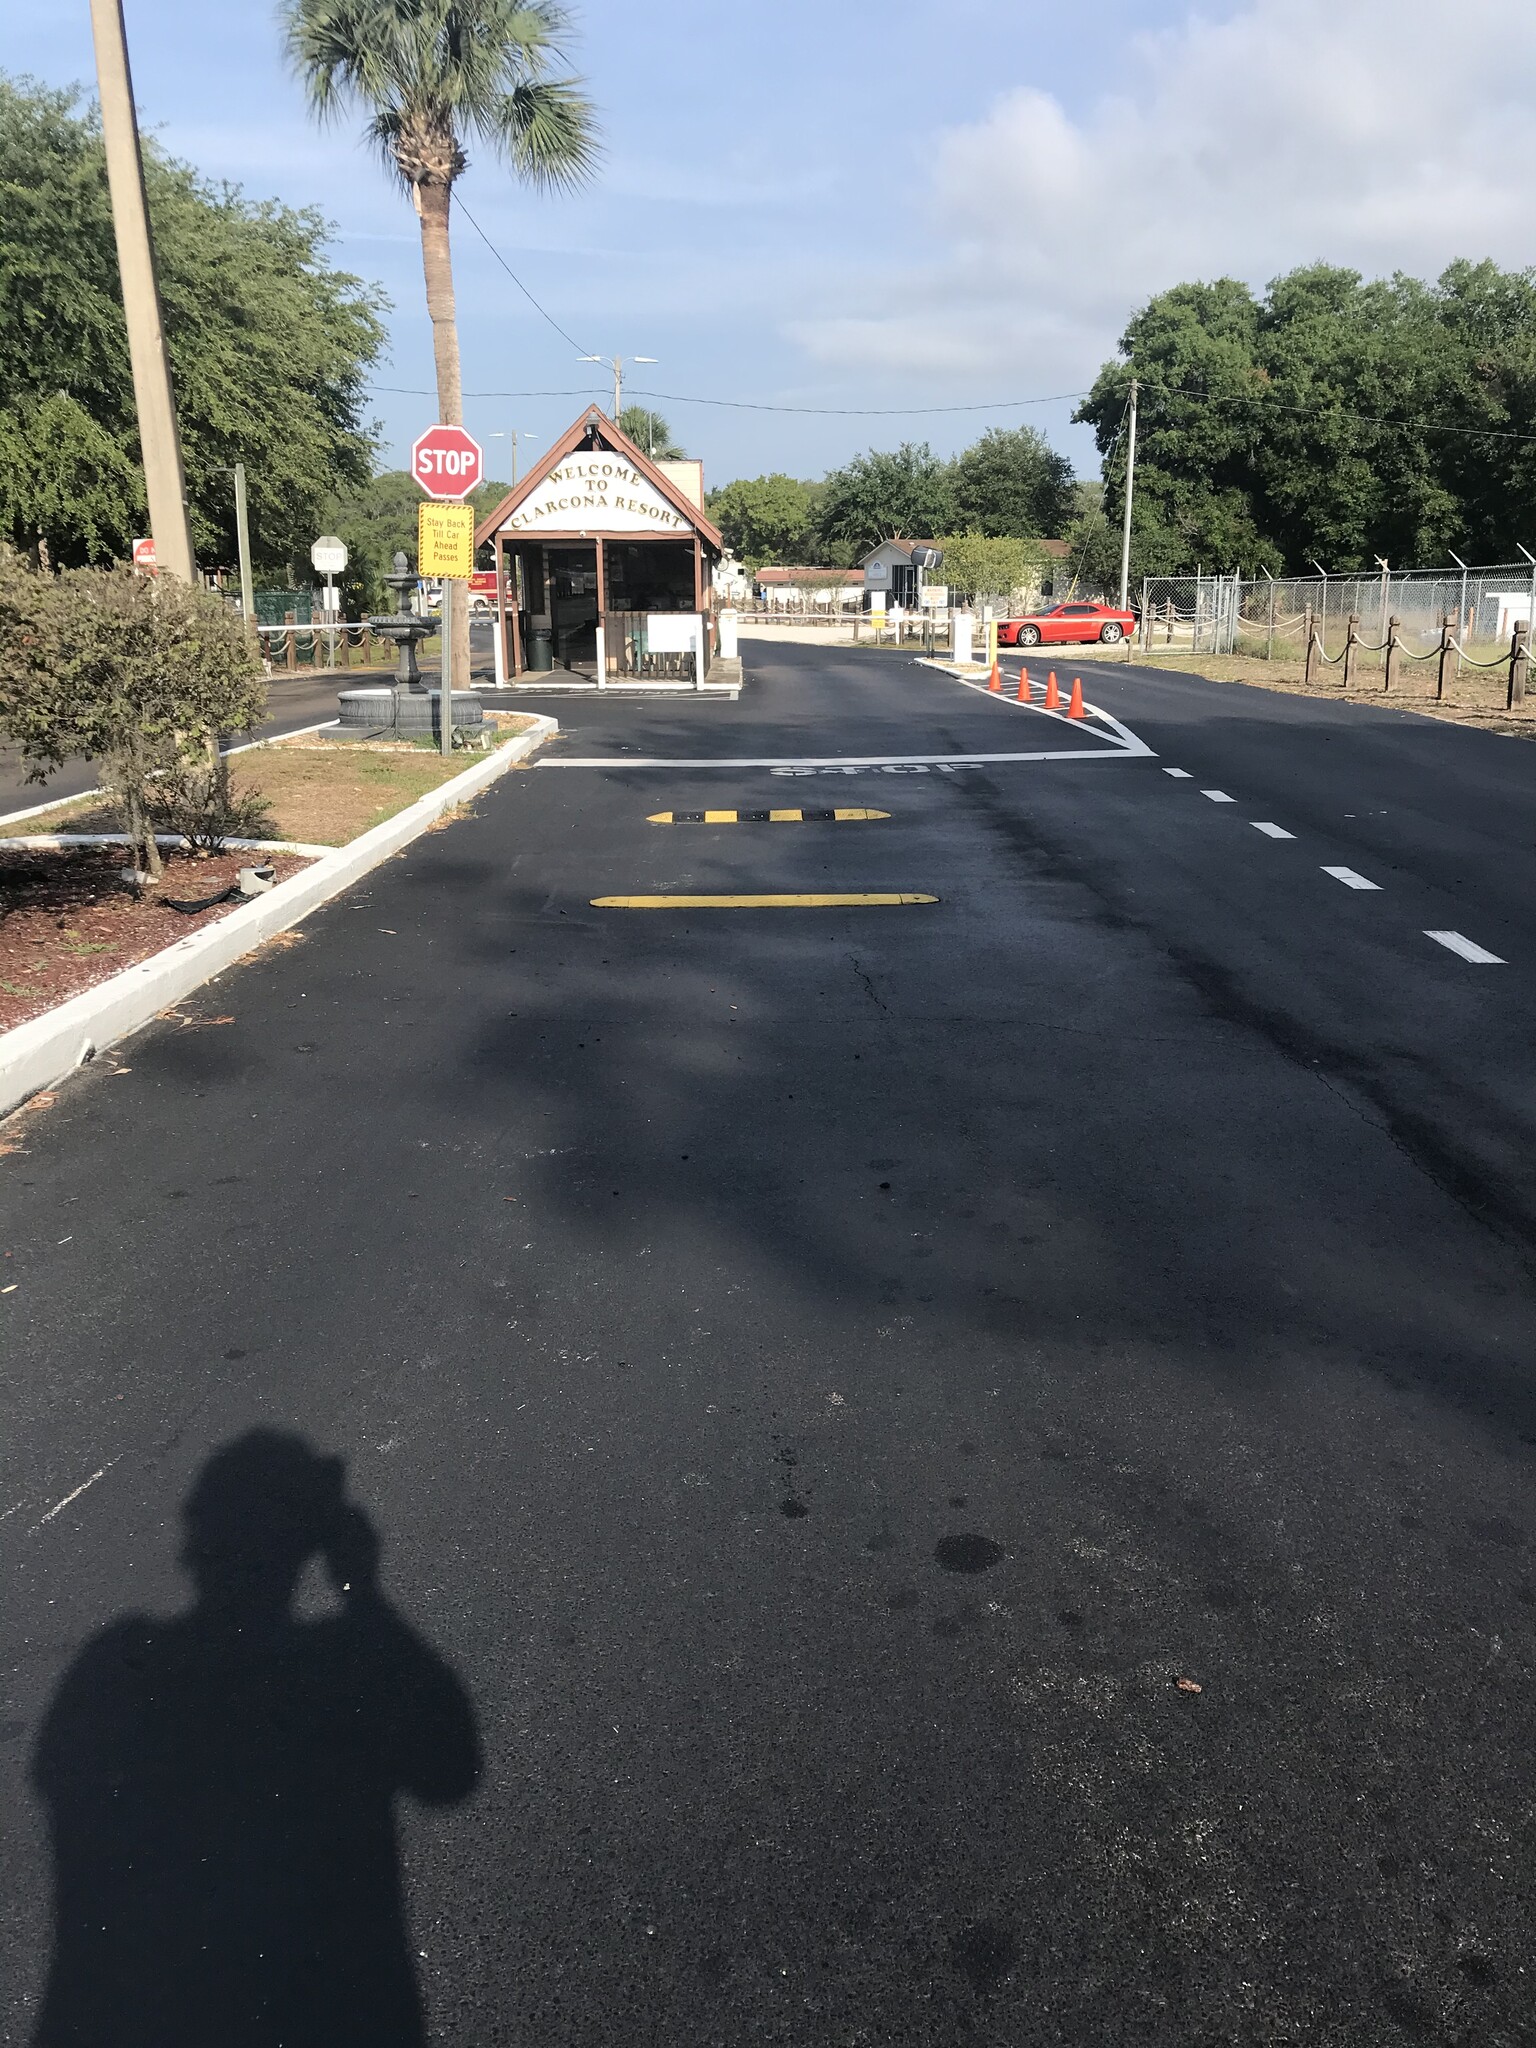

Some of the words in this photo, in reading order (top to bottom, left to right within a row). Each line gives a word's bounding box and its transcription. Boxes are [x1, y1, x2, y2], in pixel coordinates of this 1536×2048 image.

[418, 448, 476, 476] STOP
[549, 464, 641, 486] WELCOME
[585, 479, 608, 491] TO
[511, 495, 608, 528] CLARCONA
[615, 496, 683, 528] RESORT
[427, 518, 444, 528] Stay
[447, 519, 466, 528] Back
[433, 529, 444, 538] Till
[447, 530, 459, 539] Car
[434, 541, 458, 550] Ahead
[316, 552, 343, 561] STOP
[434, 552, 458, 561] Passes
[769, 763, 985, 776] STOP
